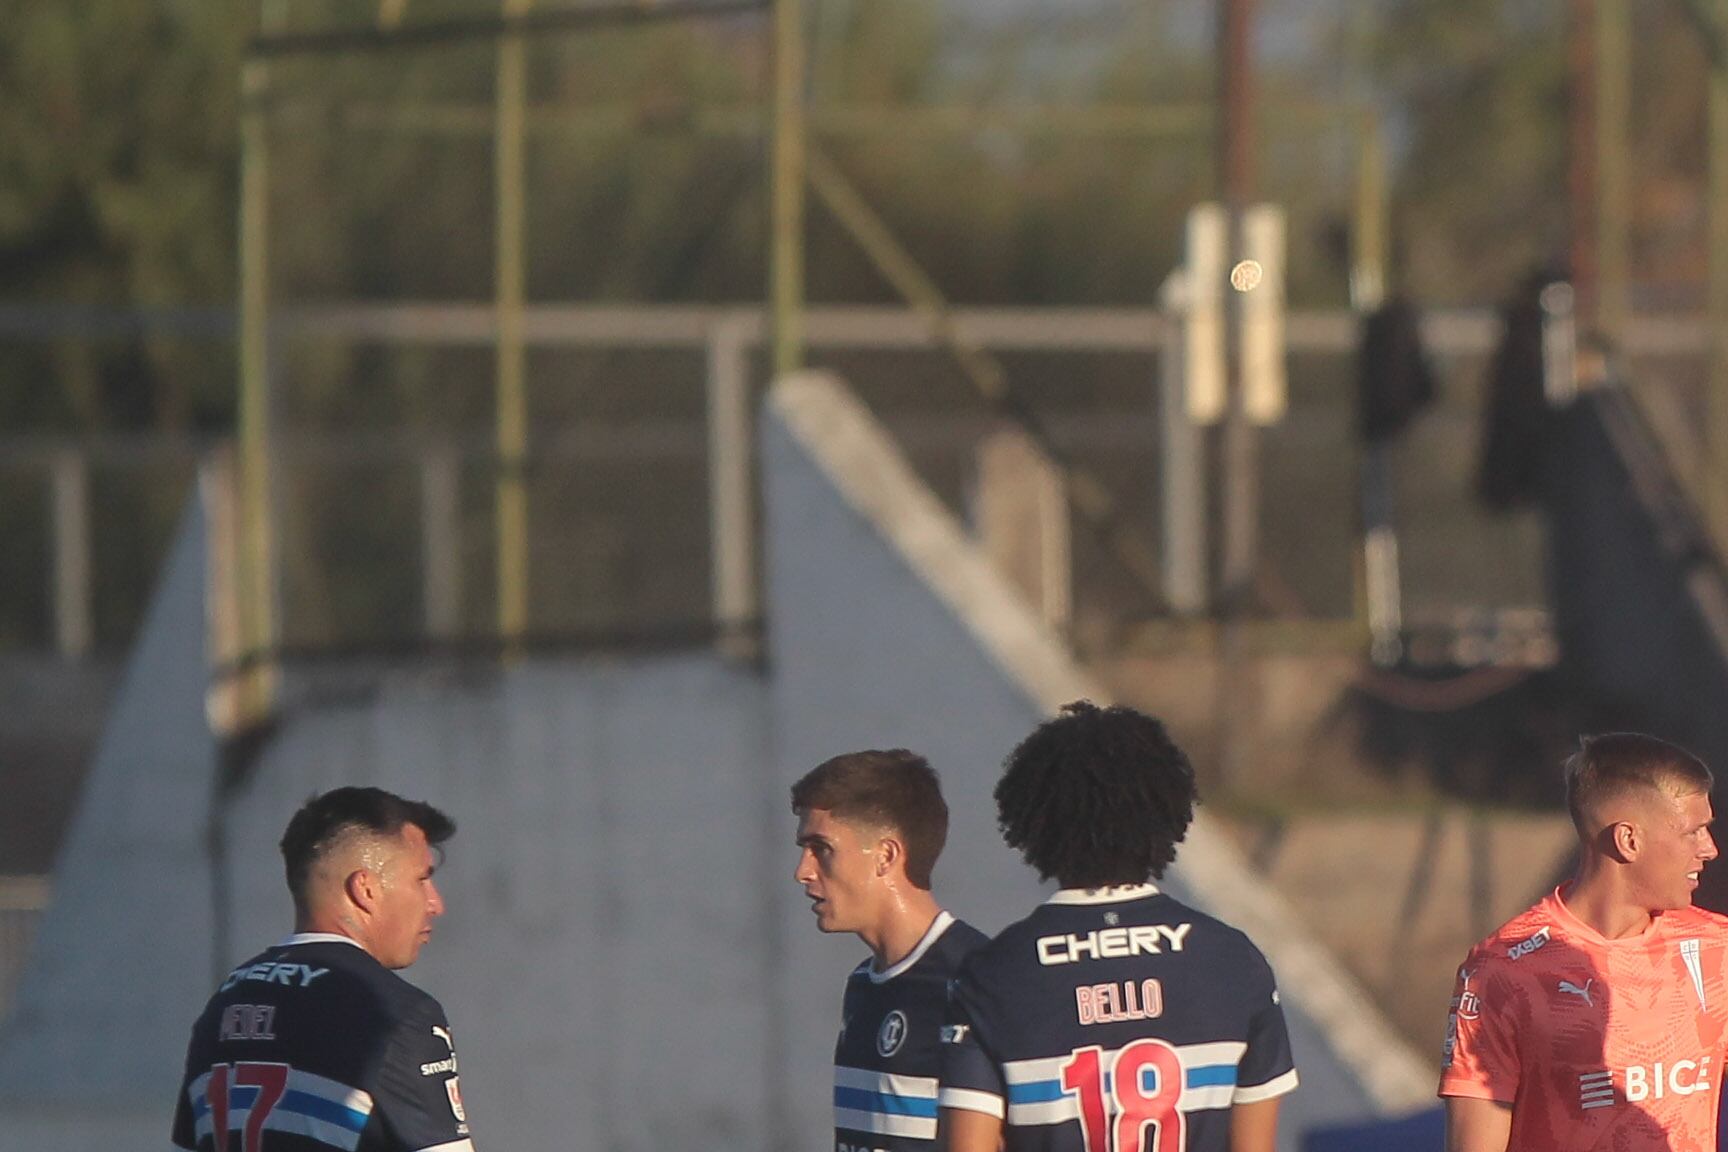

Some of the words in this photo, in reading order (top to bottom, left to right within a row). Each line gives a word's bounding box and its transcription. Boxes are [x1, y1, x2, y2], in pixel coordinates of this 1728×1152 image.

[1036, 923, 1192, 965] CHERY
[1507, 926, 1551, 960] 1XBET
[1075, 979, 1164, 1026] BELLO
[1625, 1057, 1711, 1102] BICE
